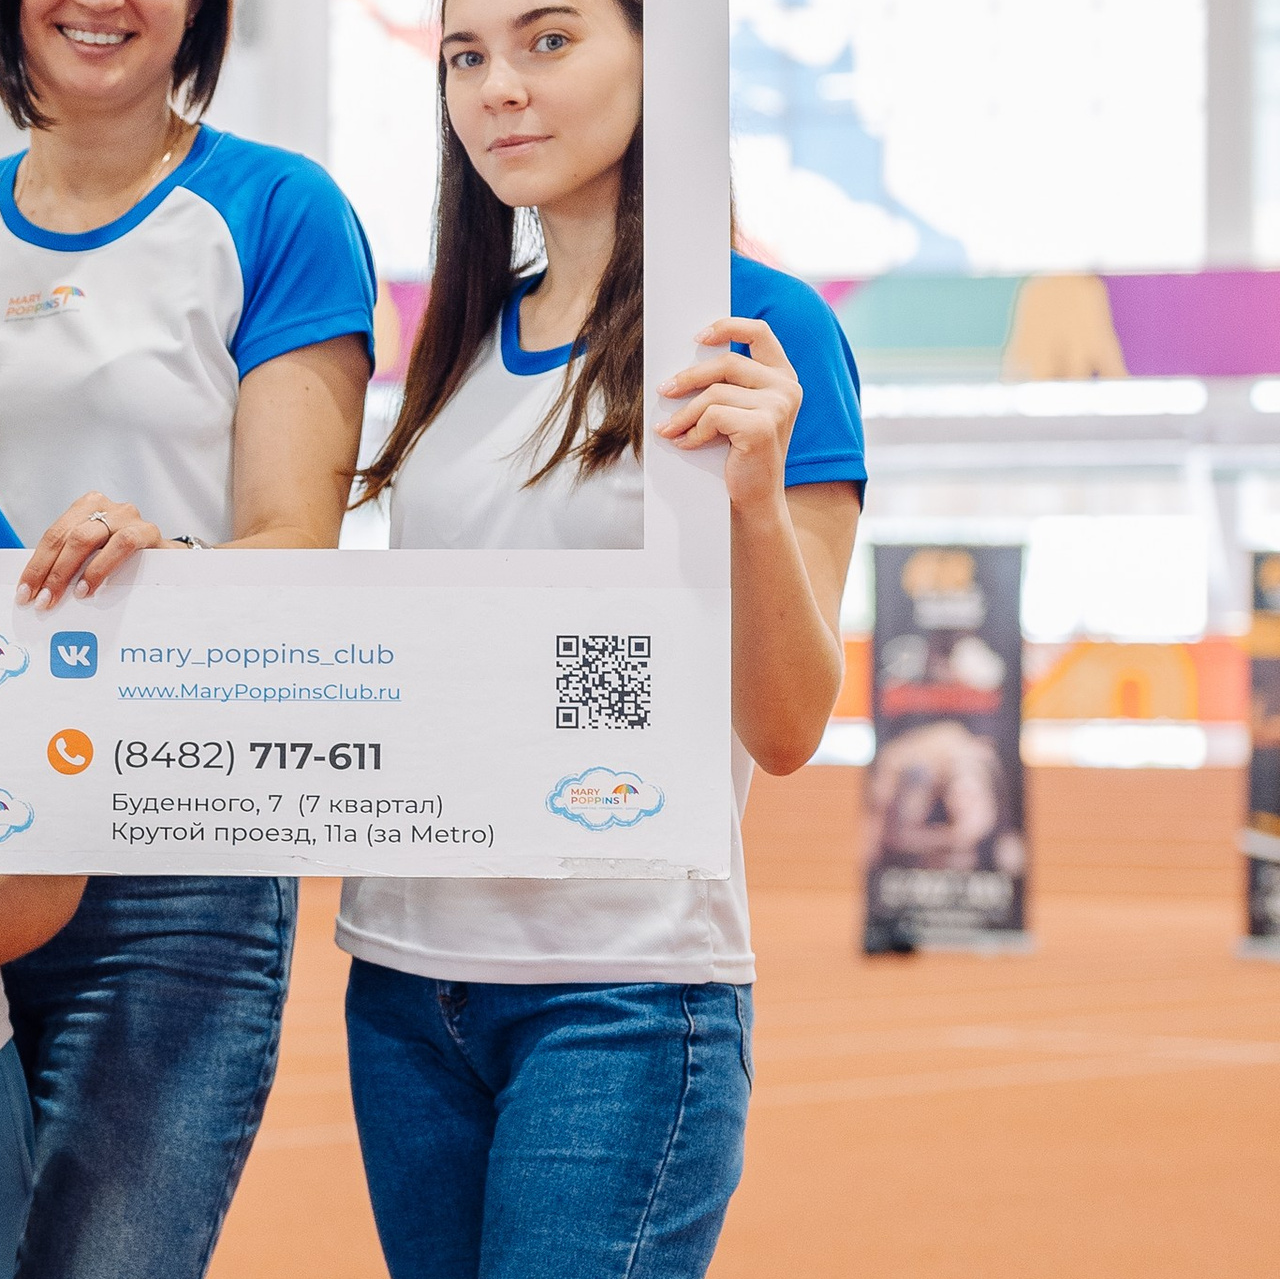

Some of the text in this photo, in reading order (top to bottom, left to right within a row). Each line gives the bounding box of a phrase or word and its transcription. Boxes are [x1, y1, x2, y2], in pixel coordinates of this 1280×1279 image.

[119, 643, 395, 668] mary_poppins_club
[118, 682, 402, 703] www.MaryPoppinsClub.ru
[114, 739, 382, 776] (8482) 717-611
[111, 792, 443, 817] Буденного, 7 (7 квартал)
[570, 788, 600, 796] MARY
[570, 796, 620, 805] POPPINS
[111, 821, 206, 846] Крутой
[214, 826, 317, 846] проезд,
[367, 823, 402, 848] (за
[411, 824, 495, 848] Metro)
